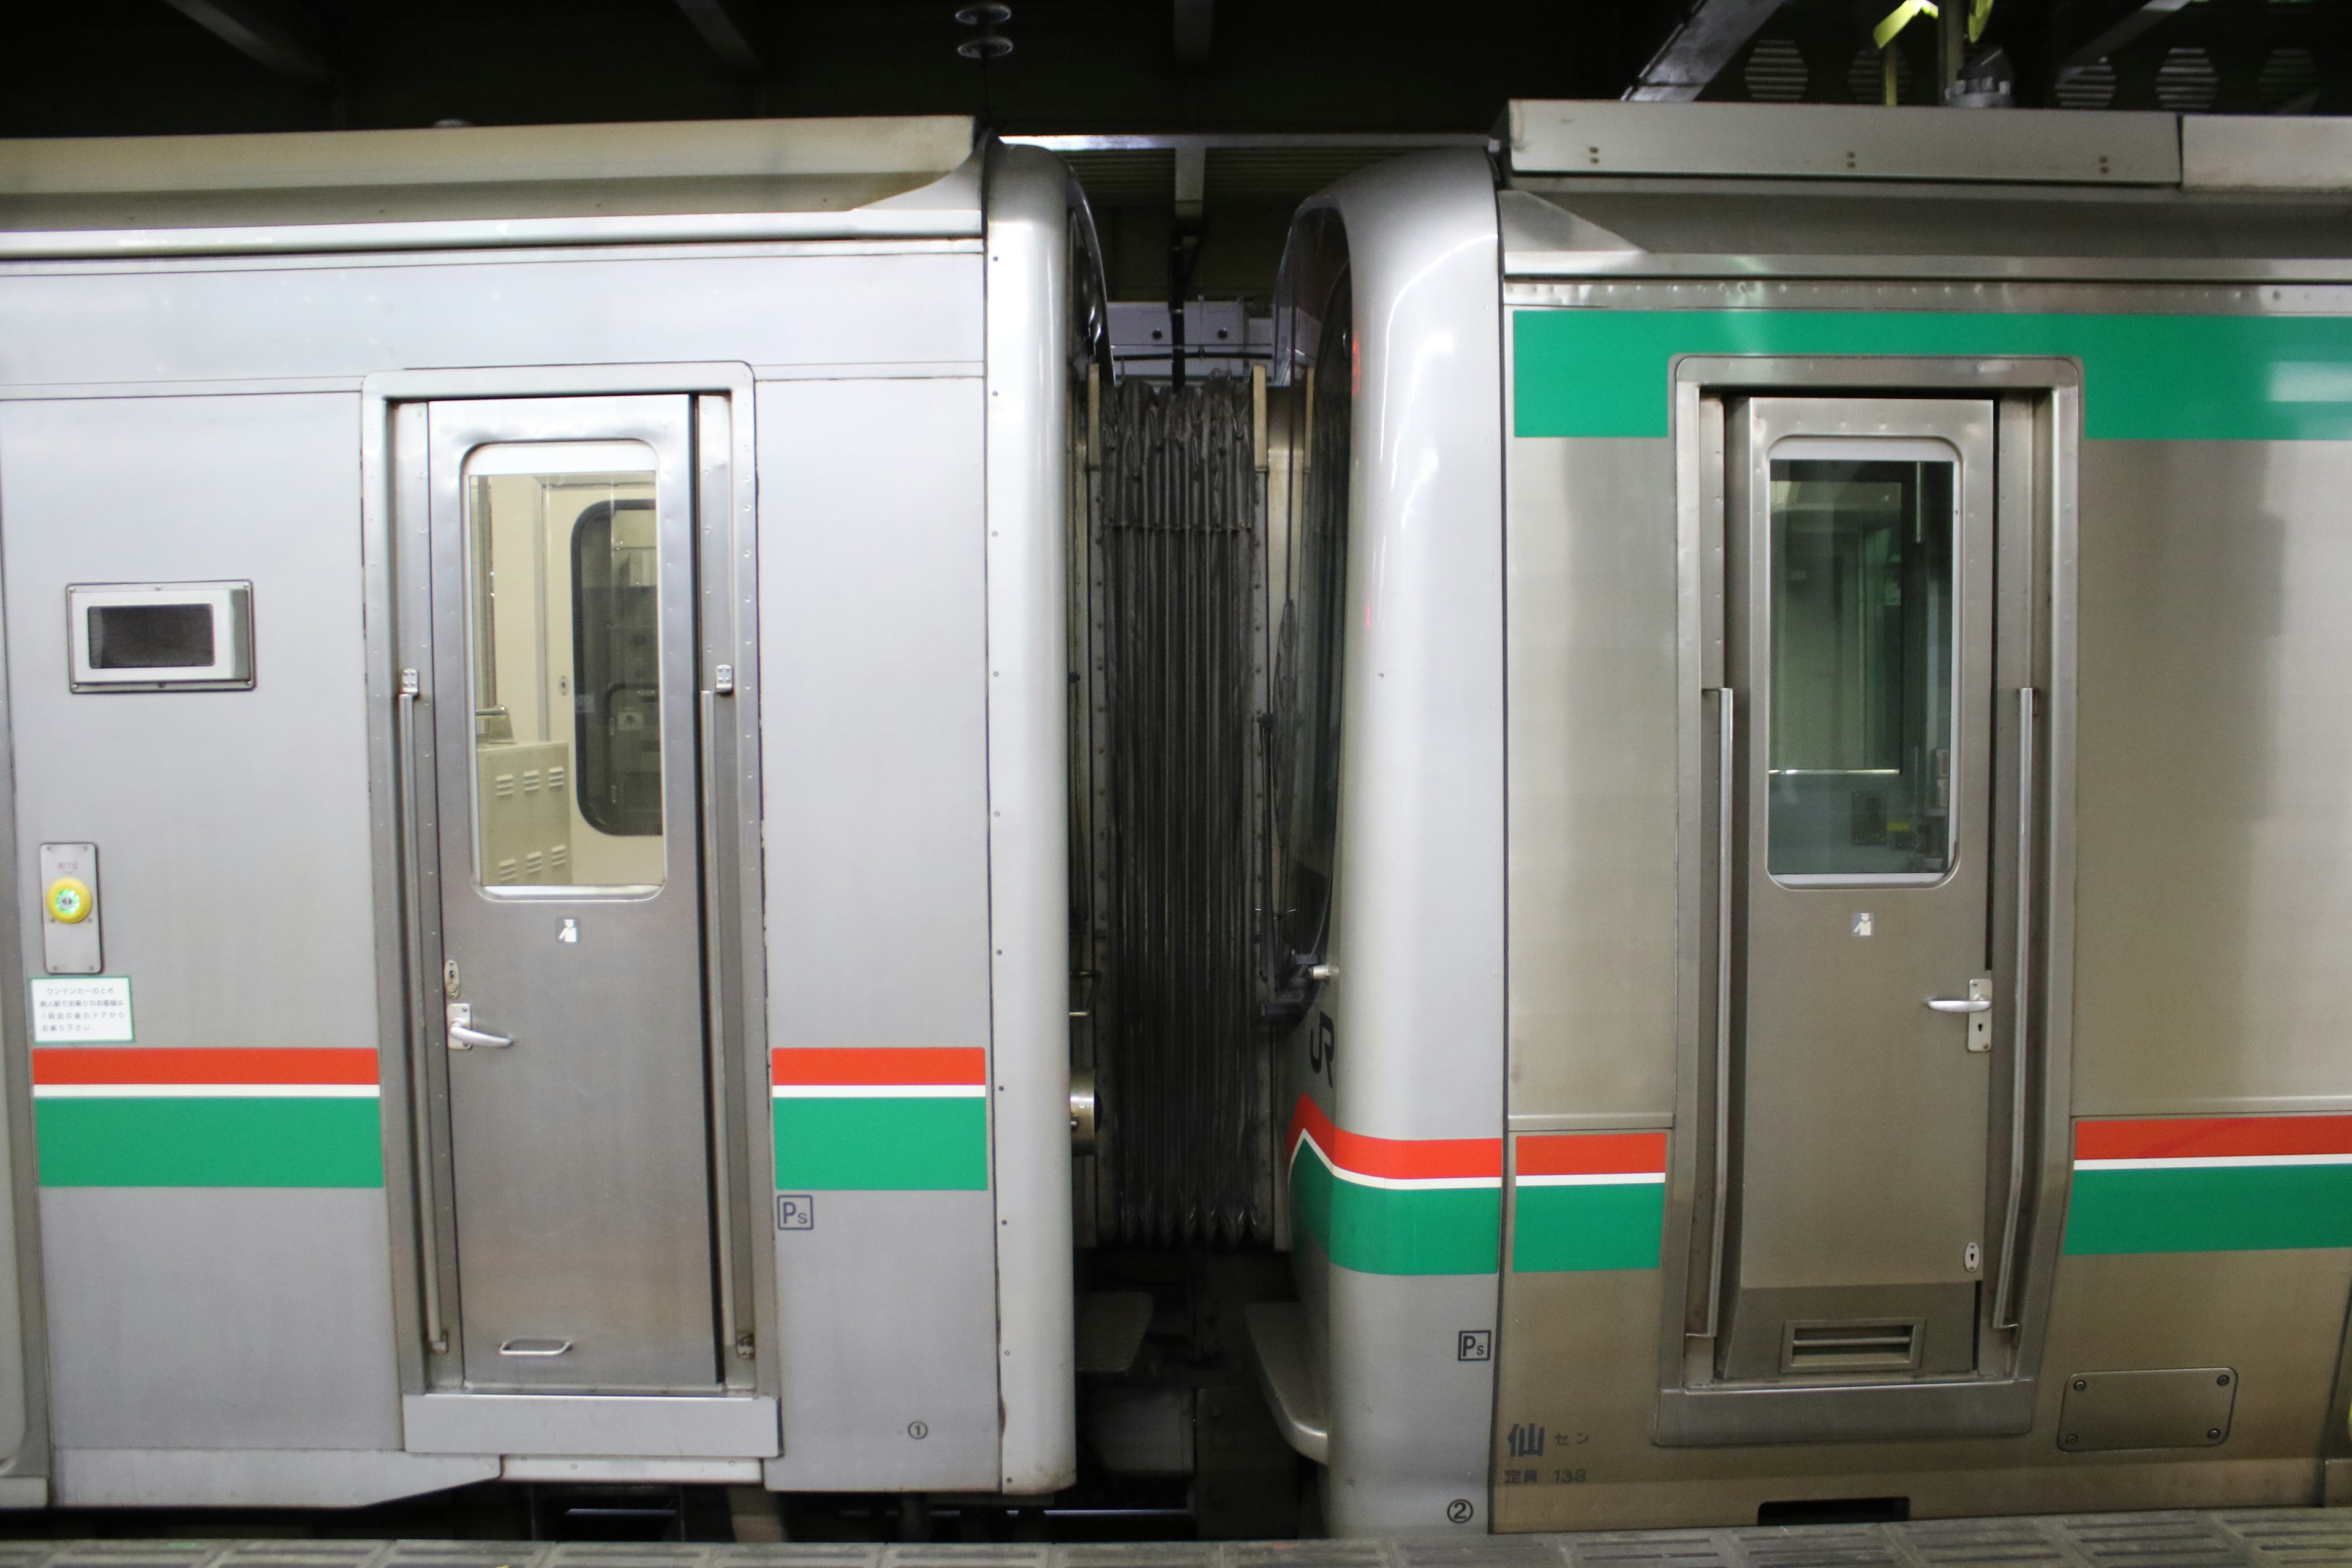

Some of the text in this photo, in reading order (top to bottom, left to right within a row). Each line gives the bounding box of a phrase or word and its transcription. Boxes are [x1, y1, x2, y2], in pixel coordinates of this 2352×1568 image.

[1310, 1011, 1335, 1088] JR
[783, 1202, 808, 1224] Ps
[1507, 1423, 1589, 1457] 仙 セン
[1554, 1469, 1586, 1483] 138
